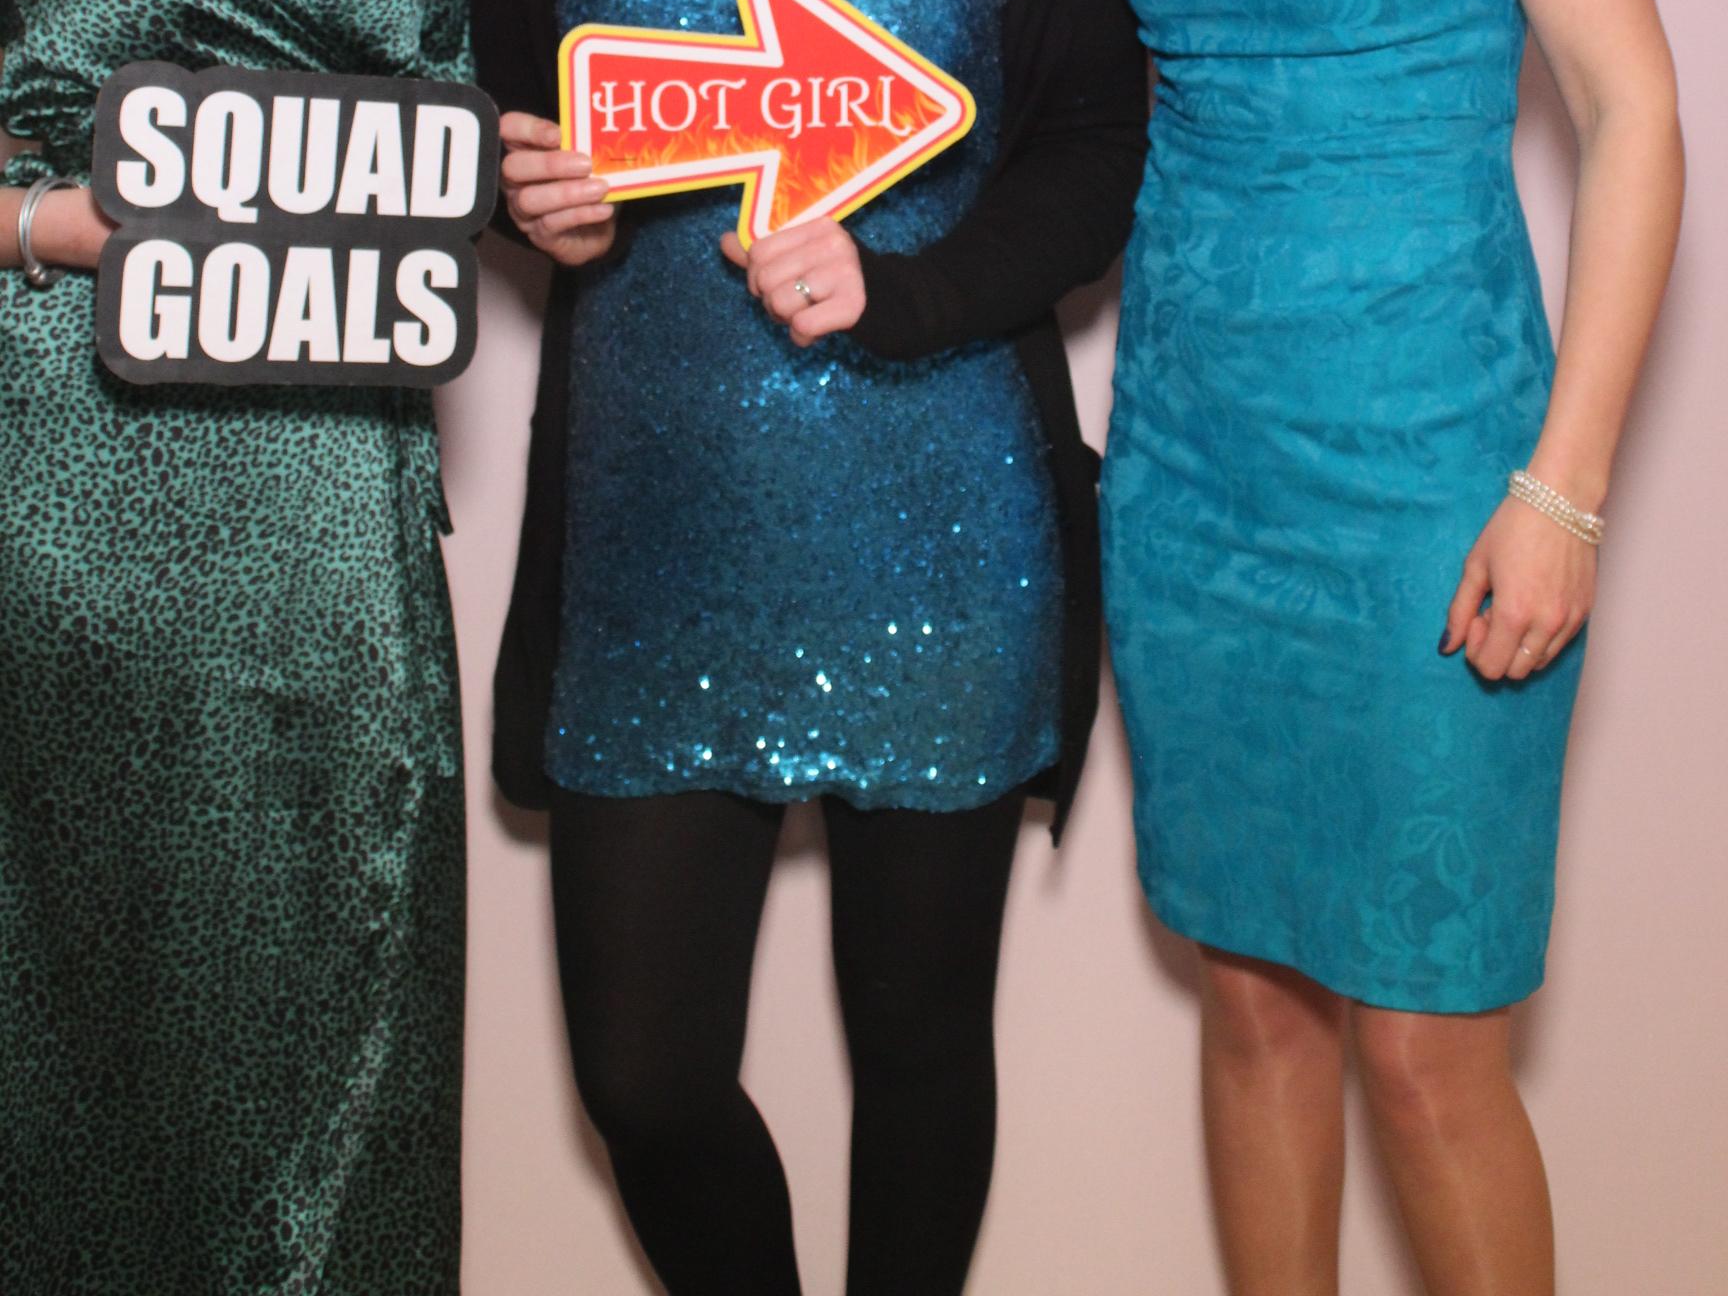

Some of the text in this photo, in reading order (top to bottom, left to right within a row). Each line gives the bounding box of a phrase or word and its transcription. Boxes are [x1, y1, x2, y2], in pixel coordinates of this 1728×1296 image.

[116, 86, 481, 224] SQUAD
[592, 75, 913, 139] HOT GIRL
[118, 239, 459, 367] GOALS
